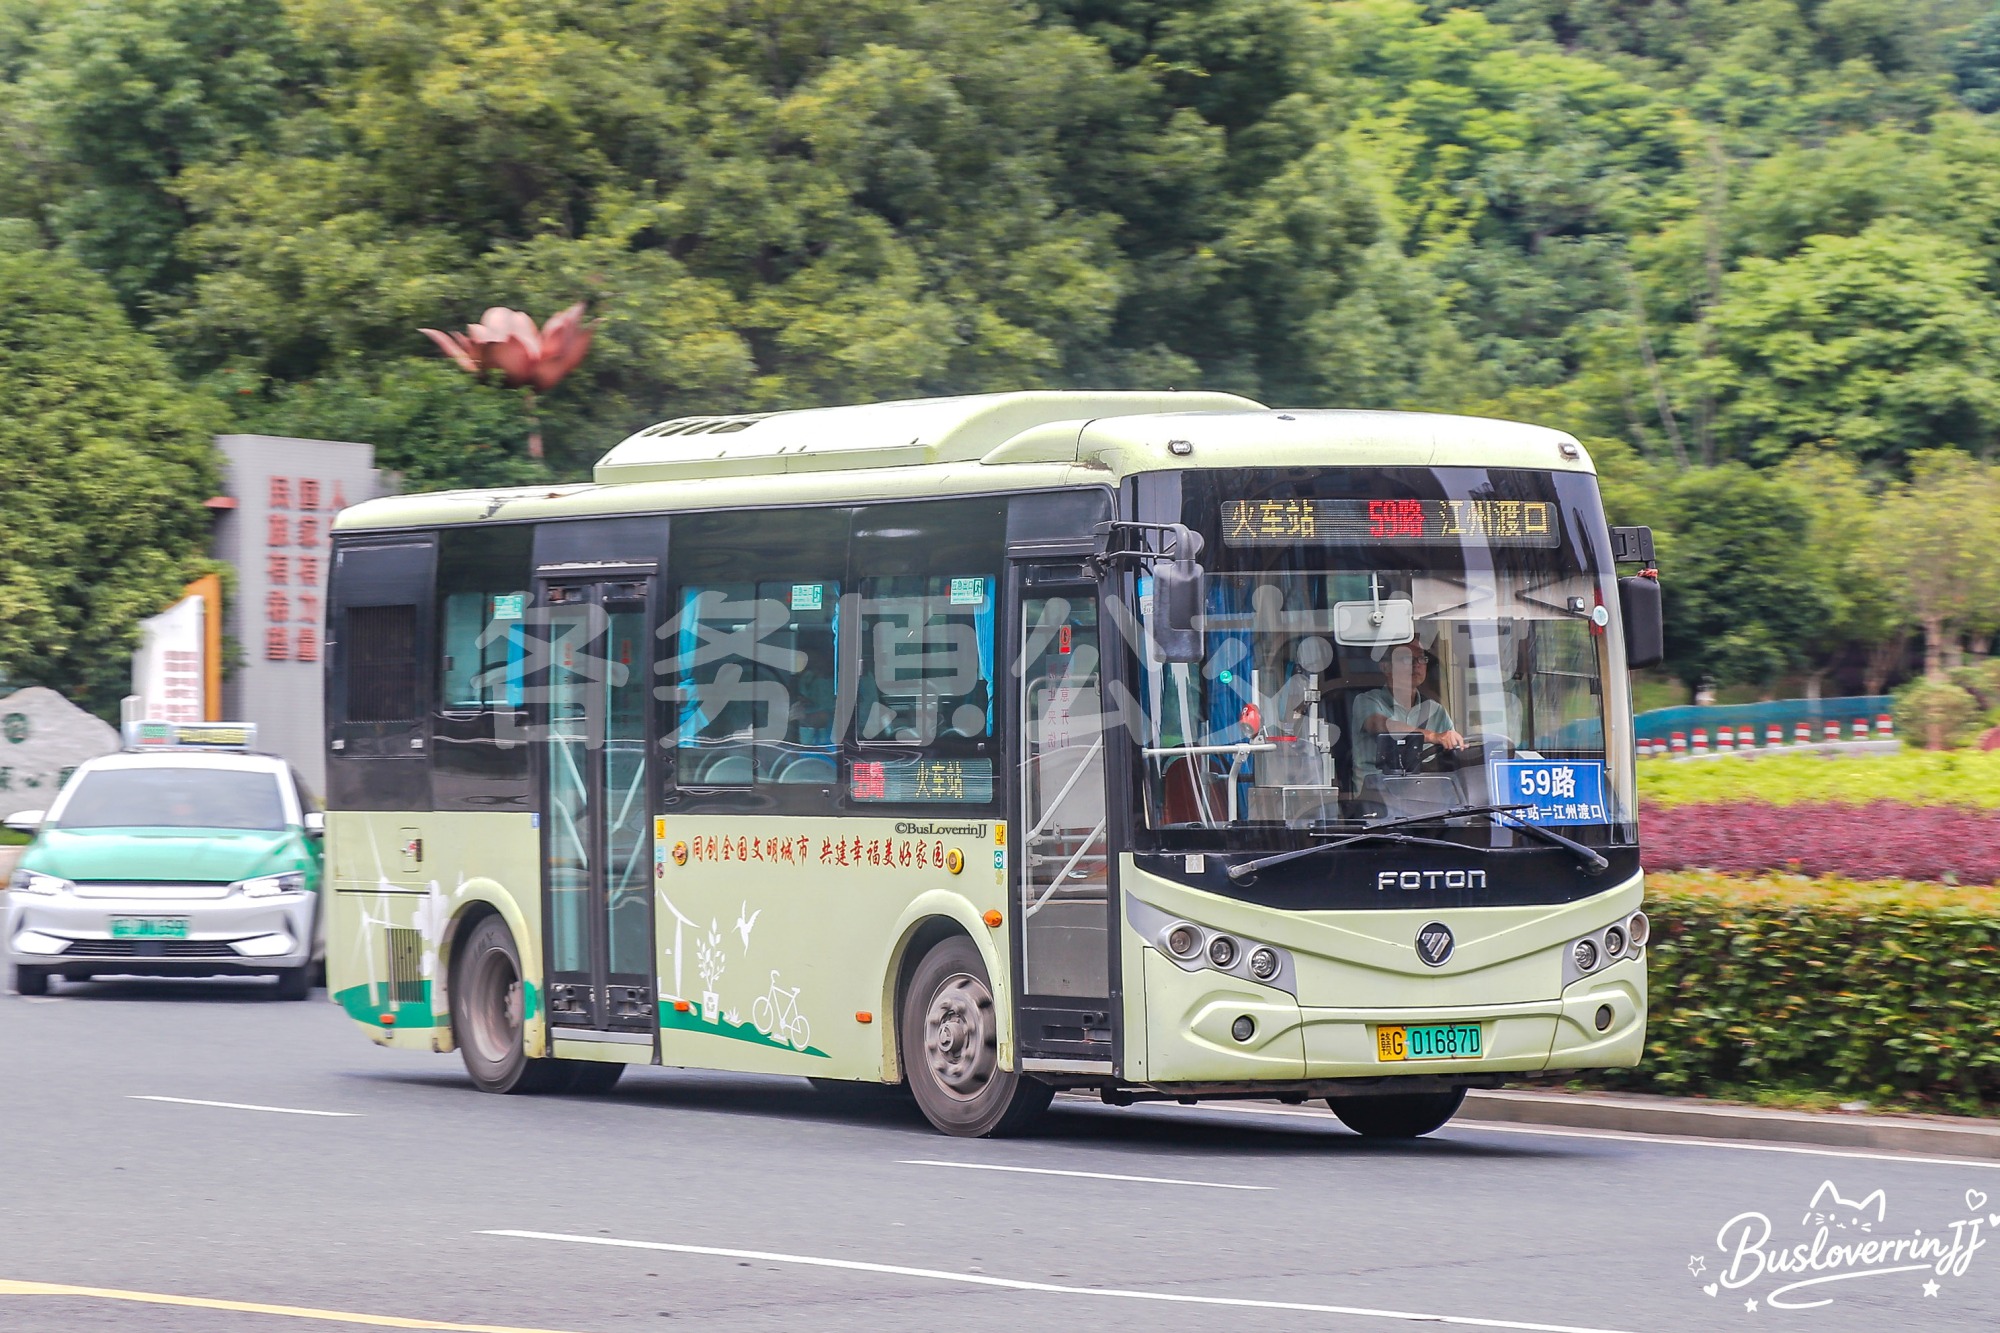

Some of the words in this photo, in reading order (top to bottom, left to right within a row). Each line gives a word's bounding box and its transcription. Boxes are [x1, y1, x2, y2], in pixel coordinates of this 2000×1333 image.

[1231, 499, 1315, 537] 火车站
[1369, 499, 1425, 538] 59路
[1440, 500, 1548, 537] 江州渡口
[916, 761, 963, 799] 火车站
[1520, 766, 1576, 798] 59路
[1553, 803, 1603, 820] 江州渡口
[692, 834, 811, 866] 同创全国文明城市
[819, 834, 945, 871] 共建幸福美好家园
[1378, 870, 1487, 891] FOTON
